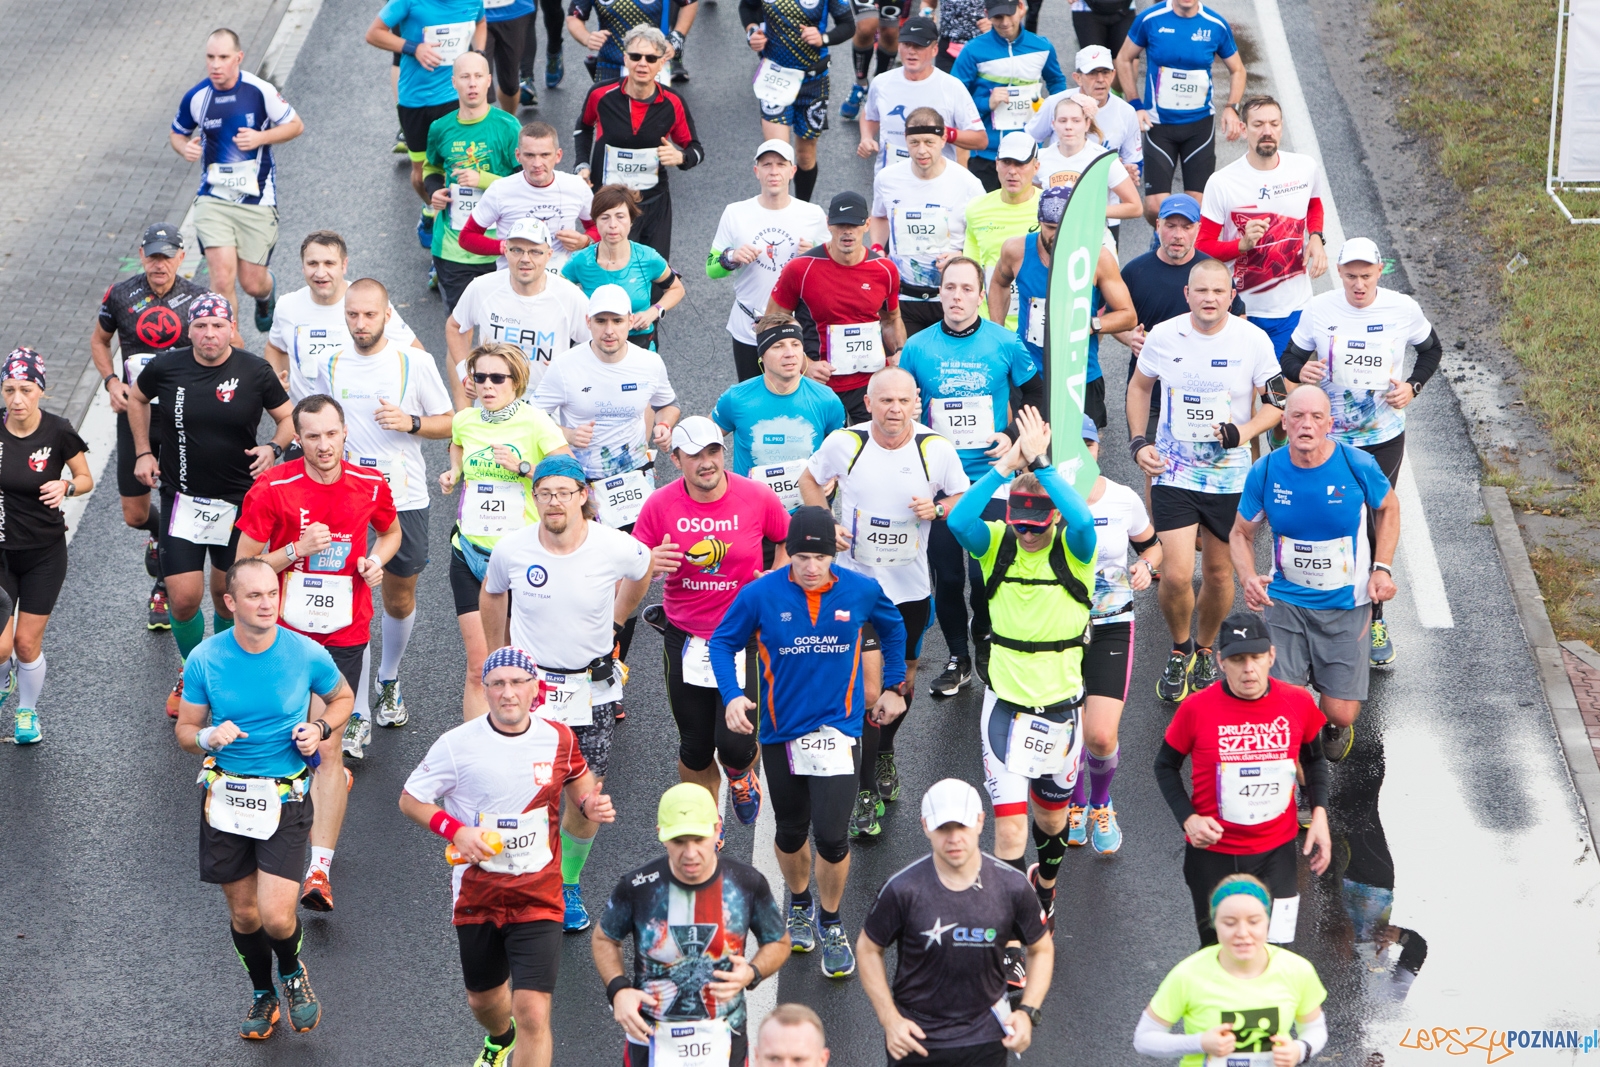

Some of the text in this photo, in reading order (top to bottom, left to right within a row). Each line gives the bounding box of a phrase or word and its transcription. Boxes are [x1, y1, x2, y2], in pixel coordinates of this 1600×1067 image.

[762, 73, 791, 89] 5962
[1171, 83, 1198, 93] 4581
[1007, 100, 1030, 111] 2185
[616, 163, 647, 173] 6876
[220, 176, 247, 188] 2610
[1273, 182, 1308, 196] MARATHON
[906, 224, 936, 235] 1032
[752, 227, 795, 247] POBIEDZISKA
[490, 323, 555, 347] TEAM
[846, 340, 873, 353] 5718
[1344, 354, 1382, 367] 2498
[1182, 371, 1200, 379] SIŁA
[1187, 379, 1224, 388] ODWAGA
[174, 386, 186, 428] DUCHEM
[594, 400, 612, 408] SIŁA
[600, 405, 636, 414] ODWAGA
[948, 414, 976, 427] 1213
[1186, 408, 1214, 421] 559
[178, 430, 187, 443] ZA
[178, 444, 187, 482] POGONI
[608, 488, 643, 507] 3586
[480, 500, 505, 512] 421
[193, 508, 220, 523] 764
[676, 514, 739, 533] OSOm!
[867, 532, 908, 545] 4930
[317, 556, 342, 568] Bike
[1294, 557, 1332, 570] 6763
[530, 571, 544, 582] PZU
[682, 577, 738, 592] Runners
[522, 590, 537, 598] SPORT
[305, 594, 334, 608] 788
[793, 635, 838, 646] GOSŁAW
[779, 644, 850, 655] SPORT CENTER
[1217, 721, 1279, 736] DRUŻYNA
[801, 737, 836, 751] 5415
[1218, 732, 1291, 753] SZPIKU
[1220, 751, 1288, 762] www.darszpiku.pl
[1238, 782, 1280, 797] 4773
[225, 794, 267, 811] 3589
[499, 820, 517, 828] 17.PKO
[677, 1042, 711, 1058] 306
